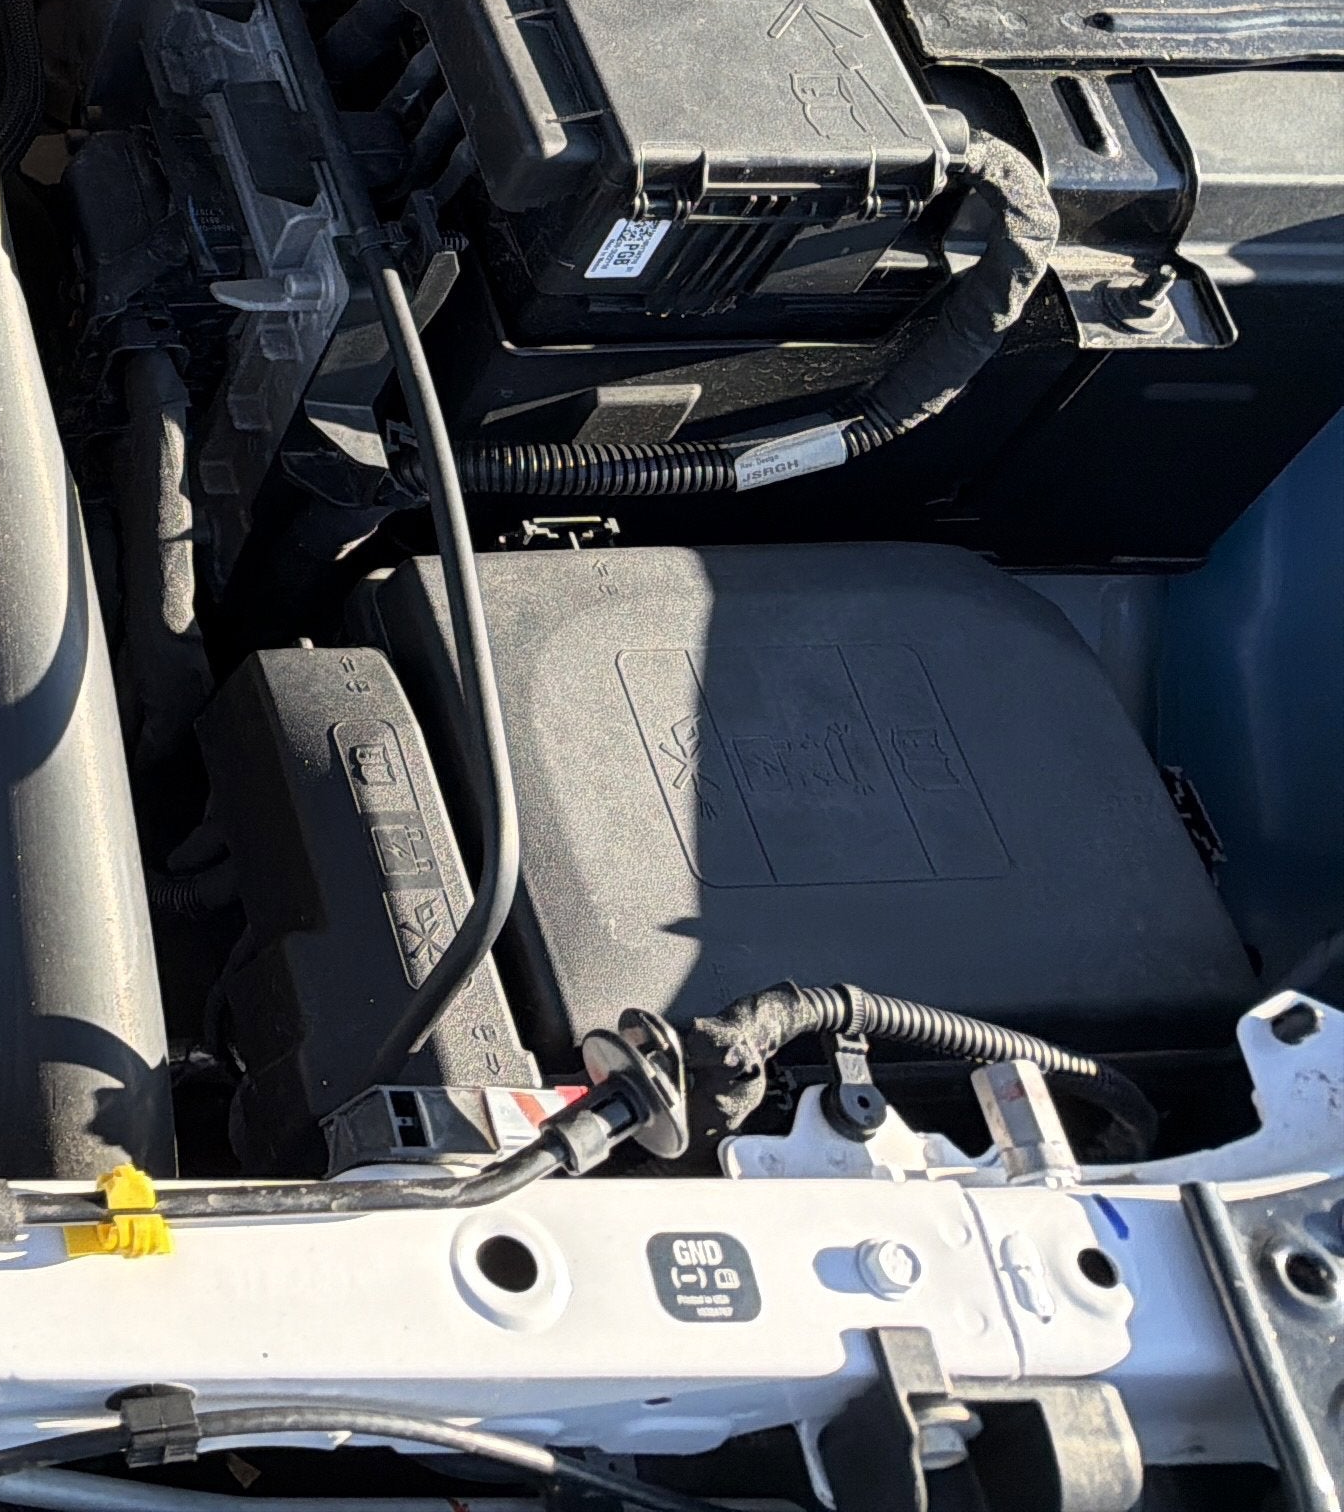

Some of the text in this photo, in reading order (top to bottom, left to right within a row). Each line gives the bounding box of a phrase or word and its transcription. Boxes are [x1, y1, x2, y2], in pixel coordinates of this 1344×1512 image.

[613, 243, 639, 265] PGB
[742, 459, 799, 482] JSRGH
[672, 1239, 723, 1266] GND
